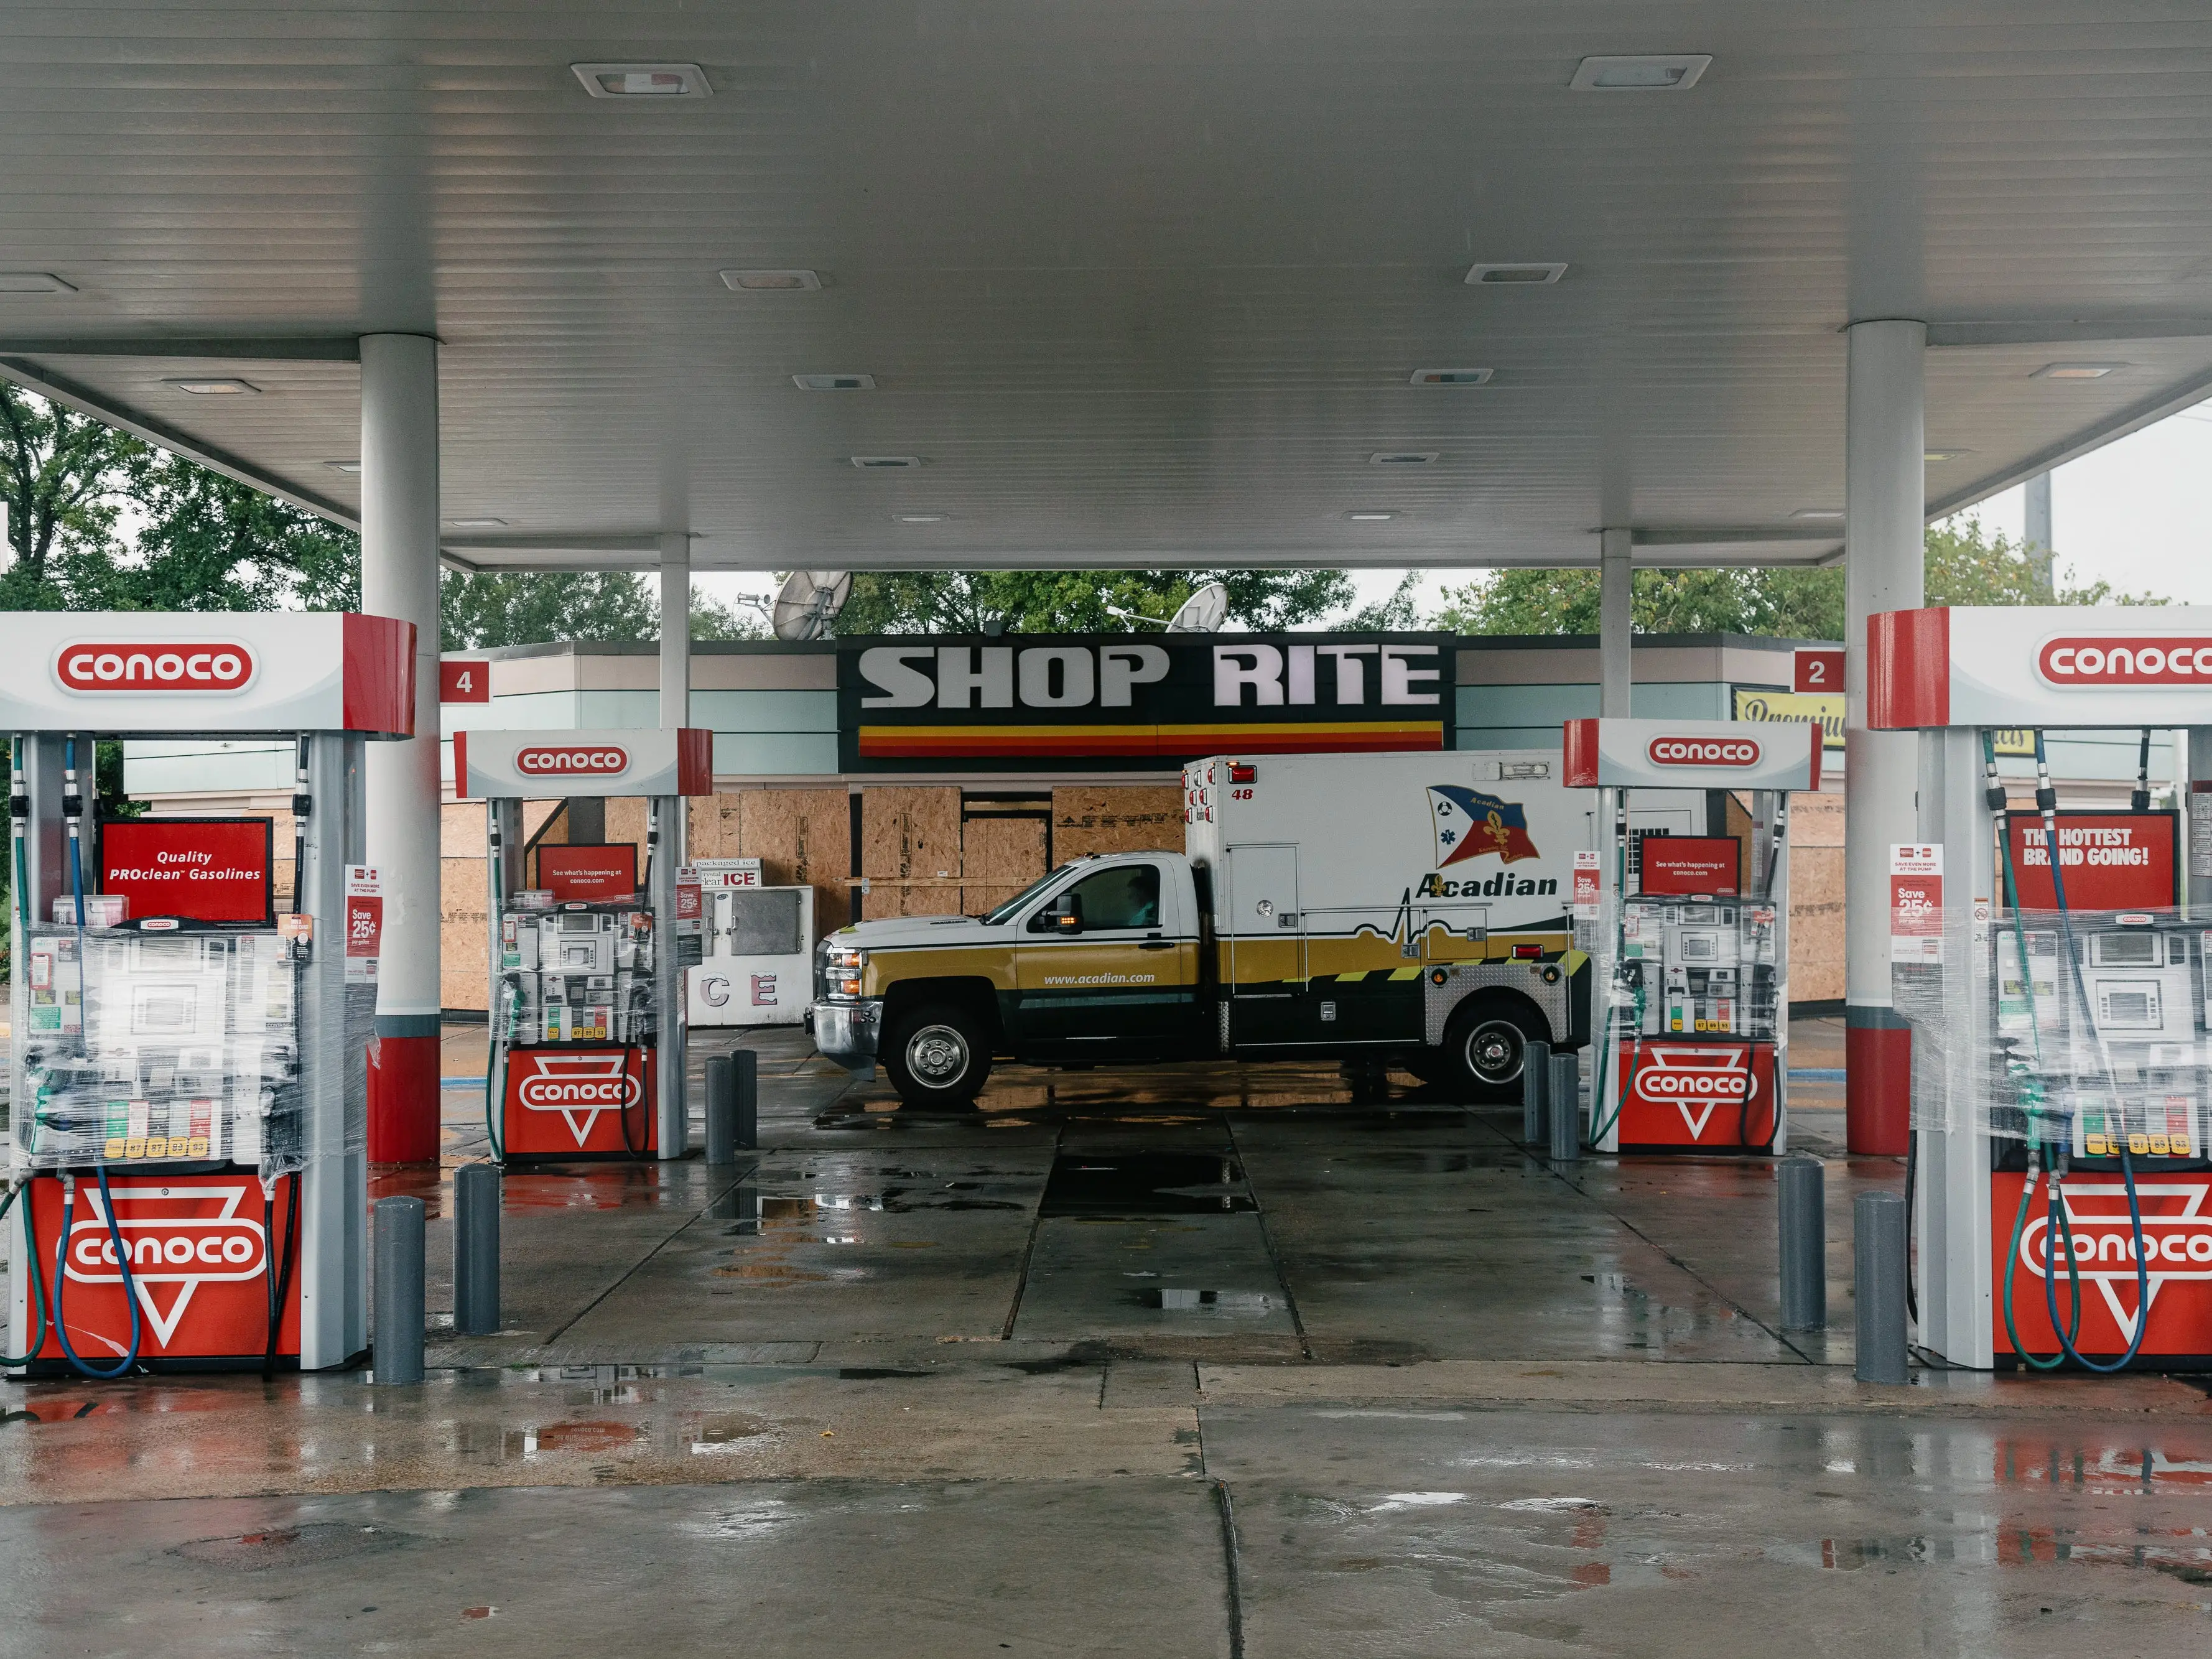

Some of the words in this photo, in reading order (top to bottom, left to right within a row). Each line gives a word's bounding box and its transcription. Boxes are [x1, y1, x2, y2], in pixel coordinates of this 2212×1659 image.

[859, 644, 1170, 709] SHOP
[1214, 644, 1441, 706] RITE
[1809, 661, 1825, 683] 2
[456, 671, 473, 692] 4
[1231, 789, 1253, 801] 48
[1471, 797, 1505, 810] Acadian
[2024, 829, 2051, 846] TH
[2060, 829, 2132, 846] HOTTEST
[157, 851, 212, 865] Quality
[2087, 848, 2149, 865] GOING!
[1687, 862, 1718, 870] happening
[189, 868, 261, 880] Gasolines
[723, 872, 755, 886] ICE
[1416, 872, 1558, 898] Acadian
[1898, 888, 1925, 899] Save
[352, 909, 371, 919] Save
[1044, 973, 1155, 985] www.acadian.com
